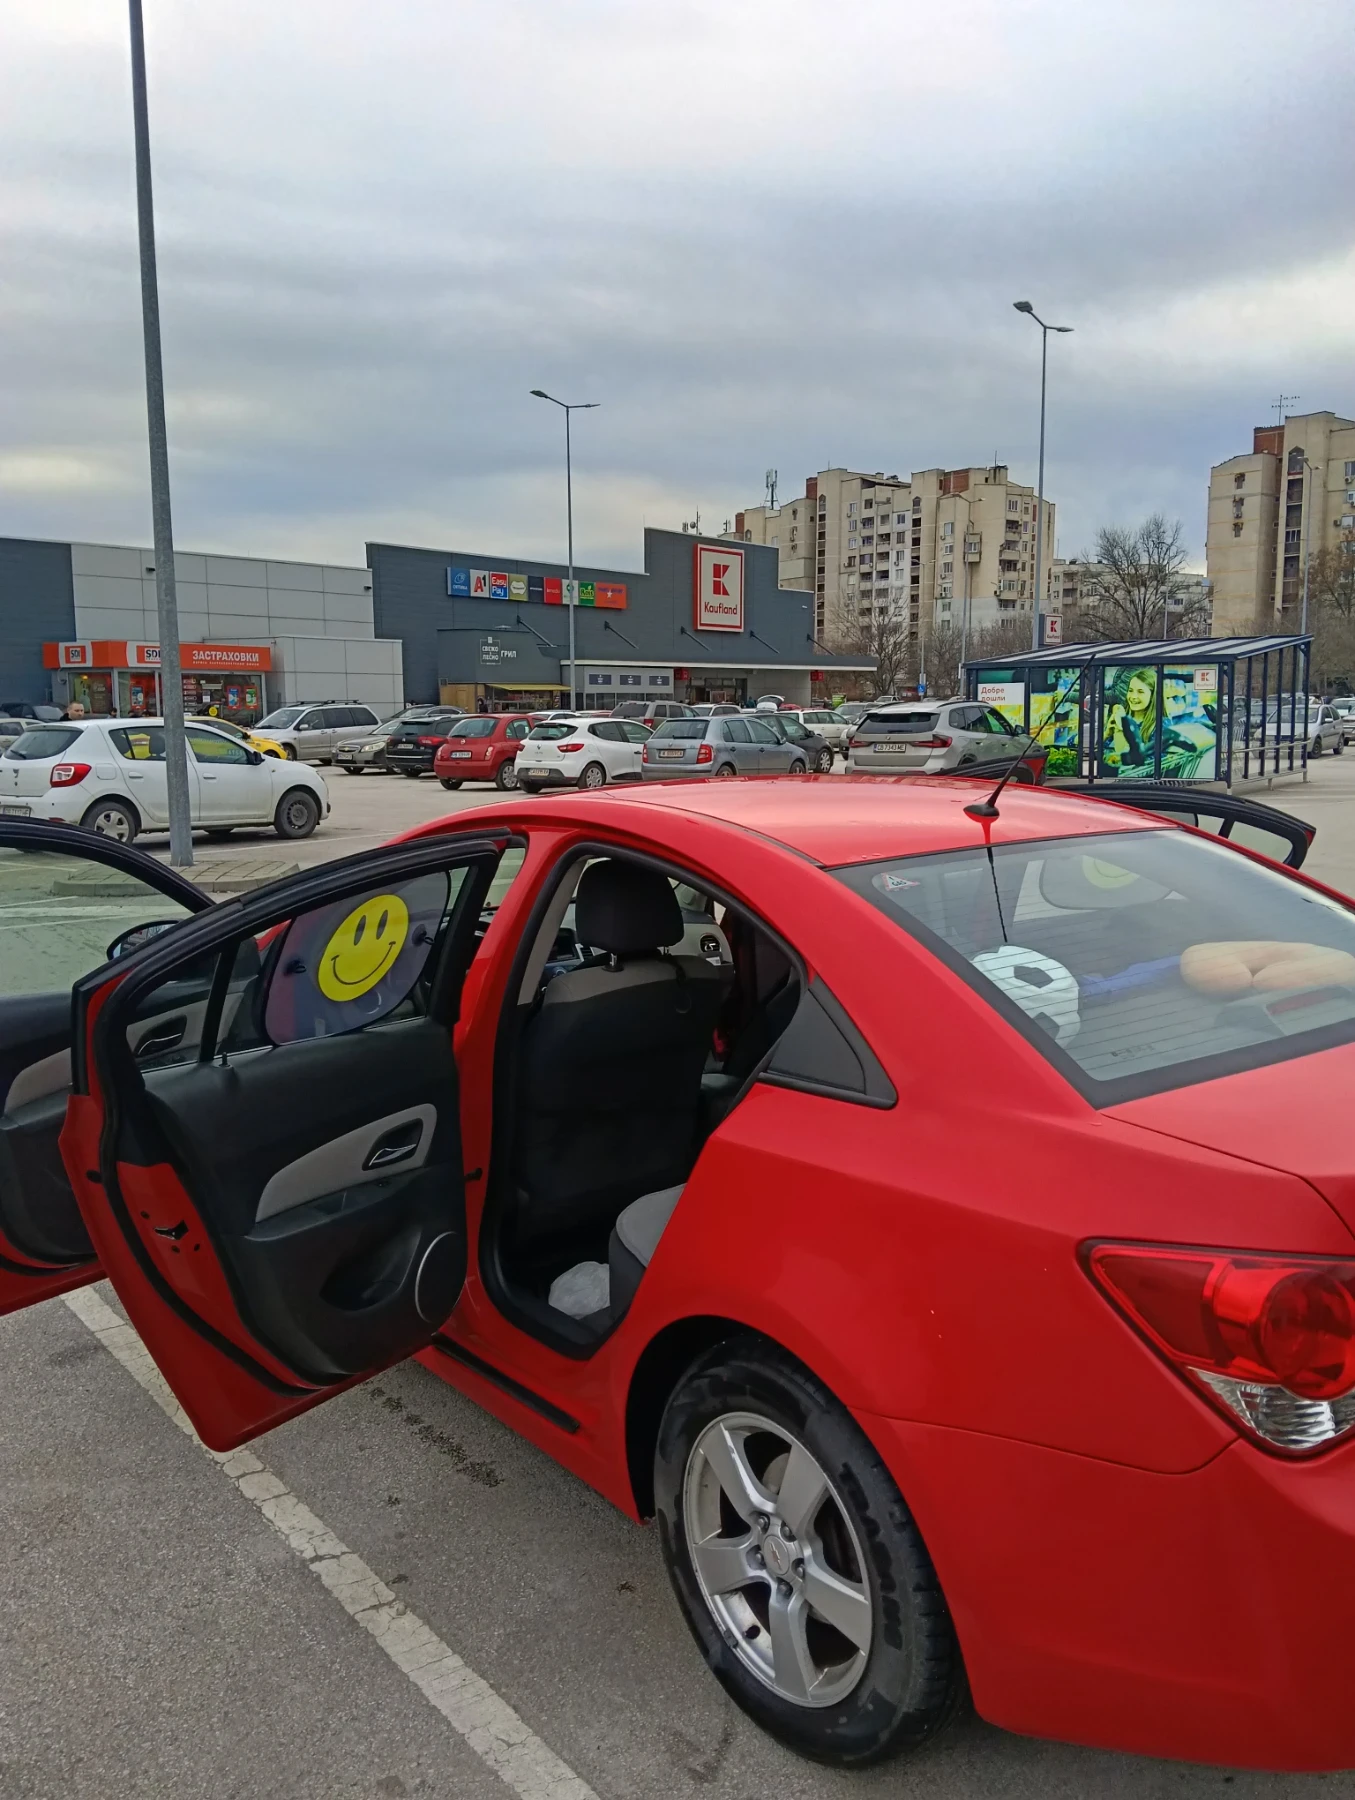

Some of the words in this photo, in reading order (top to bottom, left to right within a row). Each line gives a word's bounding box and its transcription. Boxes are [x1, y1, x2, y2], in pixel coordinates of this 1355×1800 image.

[474, 574, 487, 592] A1
[491, 577, 506, 587] Easy
[492, 586, 504, 596] Pay
[704, 601, 738, 615] Kaufland
[192, 650, 259, 662] ЗАСТРАХОВКИ
[501, 650, 517, 658] ГРИЛ
[981, 686, 1005, 694] Добре
